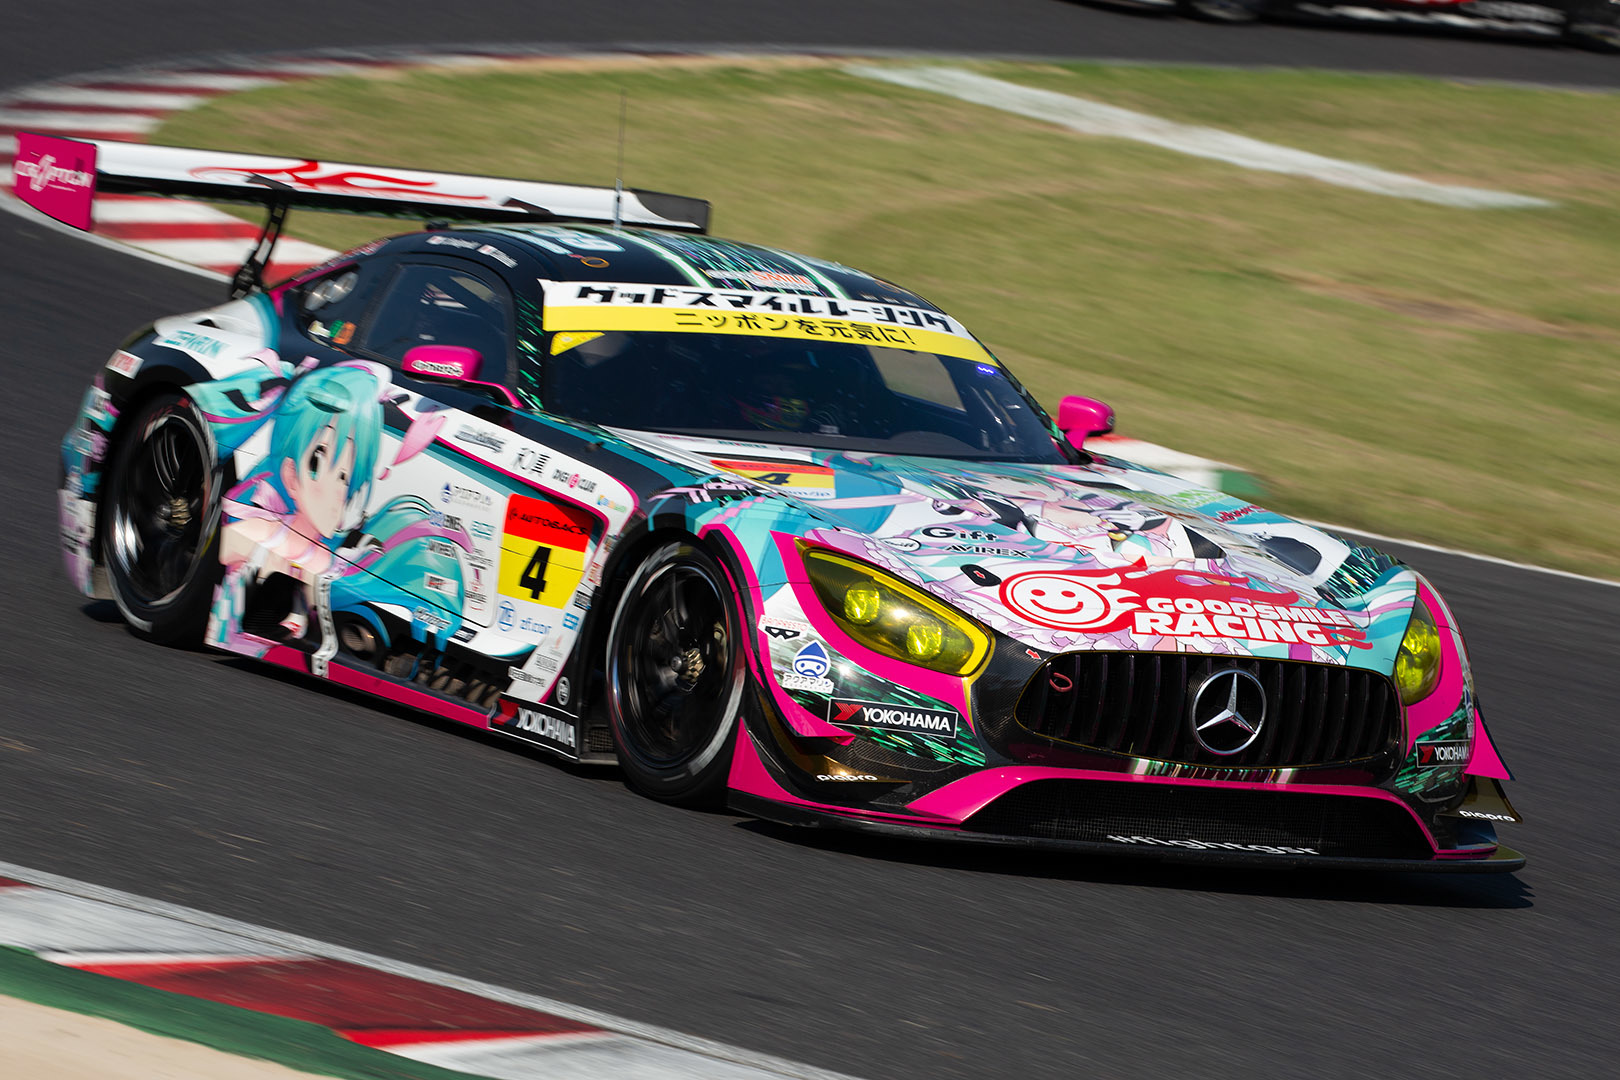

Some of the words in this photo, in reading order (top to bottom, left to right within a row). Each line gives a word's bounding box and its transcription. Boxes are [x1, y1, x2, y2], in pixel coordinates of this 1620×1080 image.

[577, 285, 956, 334] グッドスマイルレーシング
[518, 511, 590, 536] AUTOBACS
[922, 526, 999, 542] Gift
[945, 543, 1031, 559] AVIREX
[519, 545, 552, 600] 4
[1146, 597, 1353, 627] GOODSMILE
[1134, 611, 1330, 645] RACING
[517, 706, 576, 749] YOKOHAMA
[862, 707, 951, 732] YOKOHAMA
[816, 773, 878, 783] piapro
[1459, 810, 1515, 822] piapro
